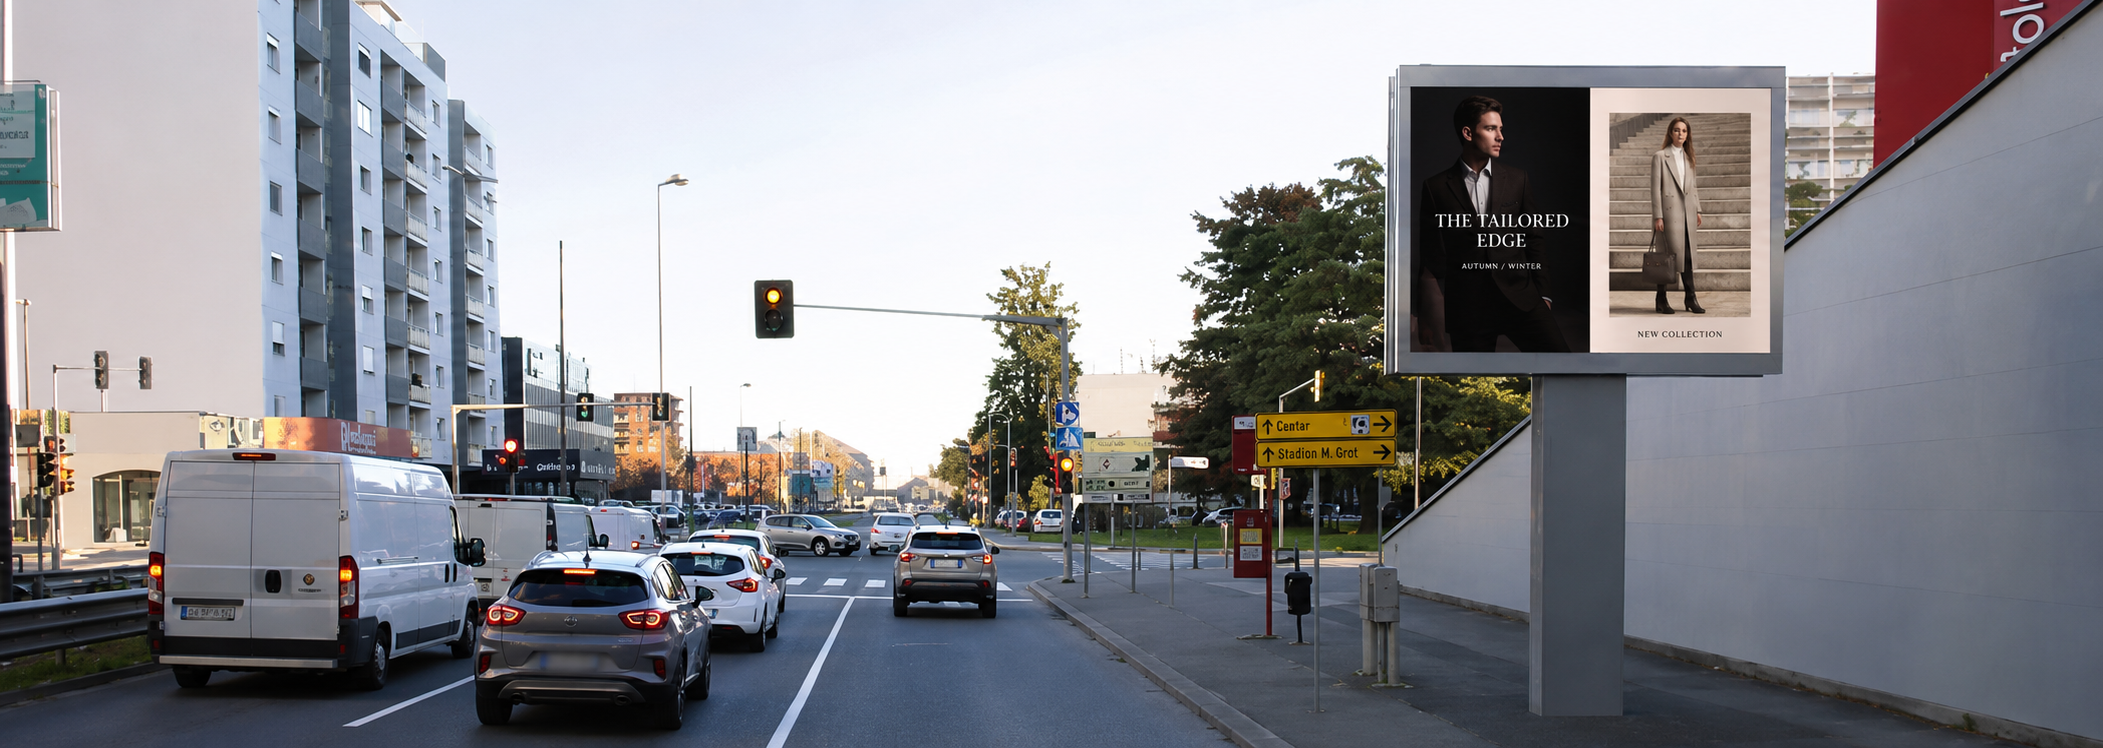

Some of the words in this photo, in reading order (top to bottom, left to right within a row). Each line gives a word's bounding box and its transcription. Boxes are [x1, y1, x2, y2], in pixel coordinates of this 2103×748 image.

[1434, 213, 1472, 228] THE
[1477, 213, 1570, 228] TAILORED
[1476, 233, 1527, 248] EDGE
[1461, 262, 1499, 270] AUTUMN
[1501, 262, 1506, 271] /
[1508, 262, 1542, 270] WINTER
[1637, 330, 1659, 338] NEW
[1661, 330, 1723, 338] COLLECTION
[1276, 420, 1311, 432] Centar
[1278, 448, 1317, 460] Stadion
[1321, 448, 1333, 459] M.
[1336, 447, 1359, 459] Grot
